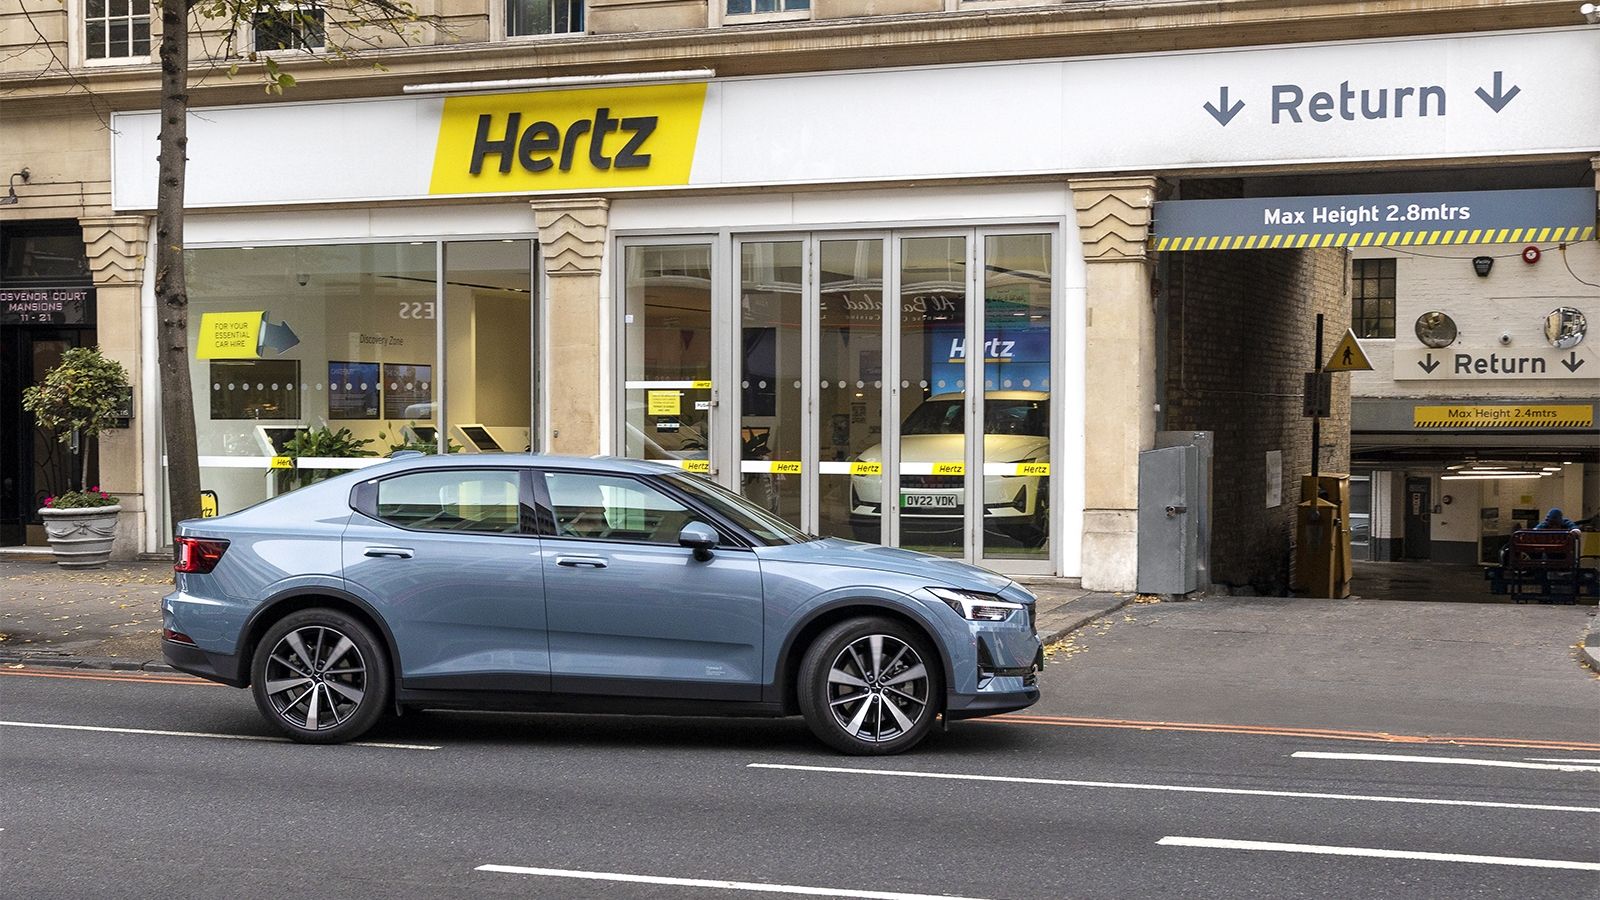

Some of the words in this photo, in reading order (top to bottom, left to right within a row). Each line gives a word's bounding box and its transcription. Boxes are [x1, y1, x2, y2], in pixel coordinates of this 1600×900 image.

[1271, 80, 1446, 124] Return
[469, 107, 659, 175] Hertz
[1264, 208, 1305, 225] Max
[1312, 205, 1379, 226] Height
[1386, 203, 1471, 222] 2.8mtrs
[0, 292, 48, 301] OSVENOR
[53, 292, 87, 300] COURT
[9, 303, 62, 311] MANSIONS
[20, 313, 29, 322] 11
[39, 313, 52, 322] 21
[215, 322, 228, 330] FOR
[230, 322, 248, 330] YOUR
[360, 333, 388, 346] Discovery
[388, 335, 404, 346] Zone
[949, 338, 1016, 358] Hrtz
[1454, 353, 1546, 374] Return
[1448, 409, 1472, 418] Max
[1475, 408, 1511, 420] Height
[1514, 408, 1558, 418] 2.4mtrs
[687, 462, 710, 470] Hertz
[777, 463, 799, 472] Hertz
[857, 464, 879, 473] Hertz
[940, 464, 962, 473] Hertz
[1023, 464, 1047, 474] Hertz
[934, 496, 955, 506] VDK
